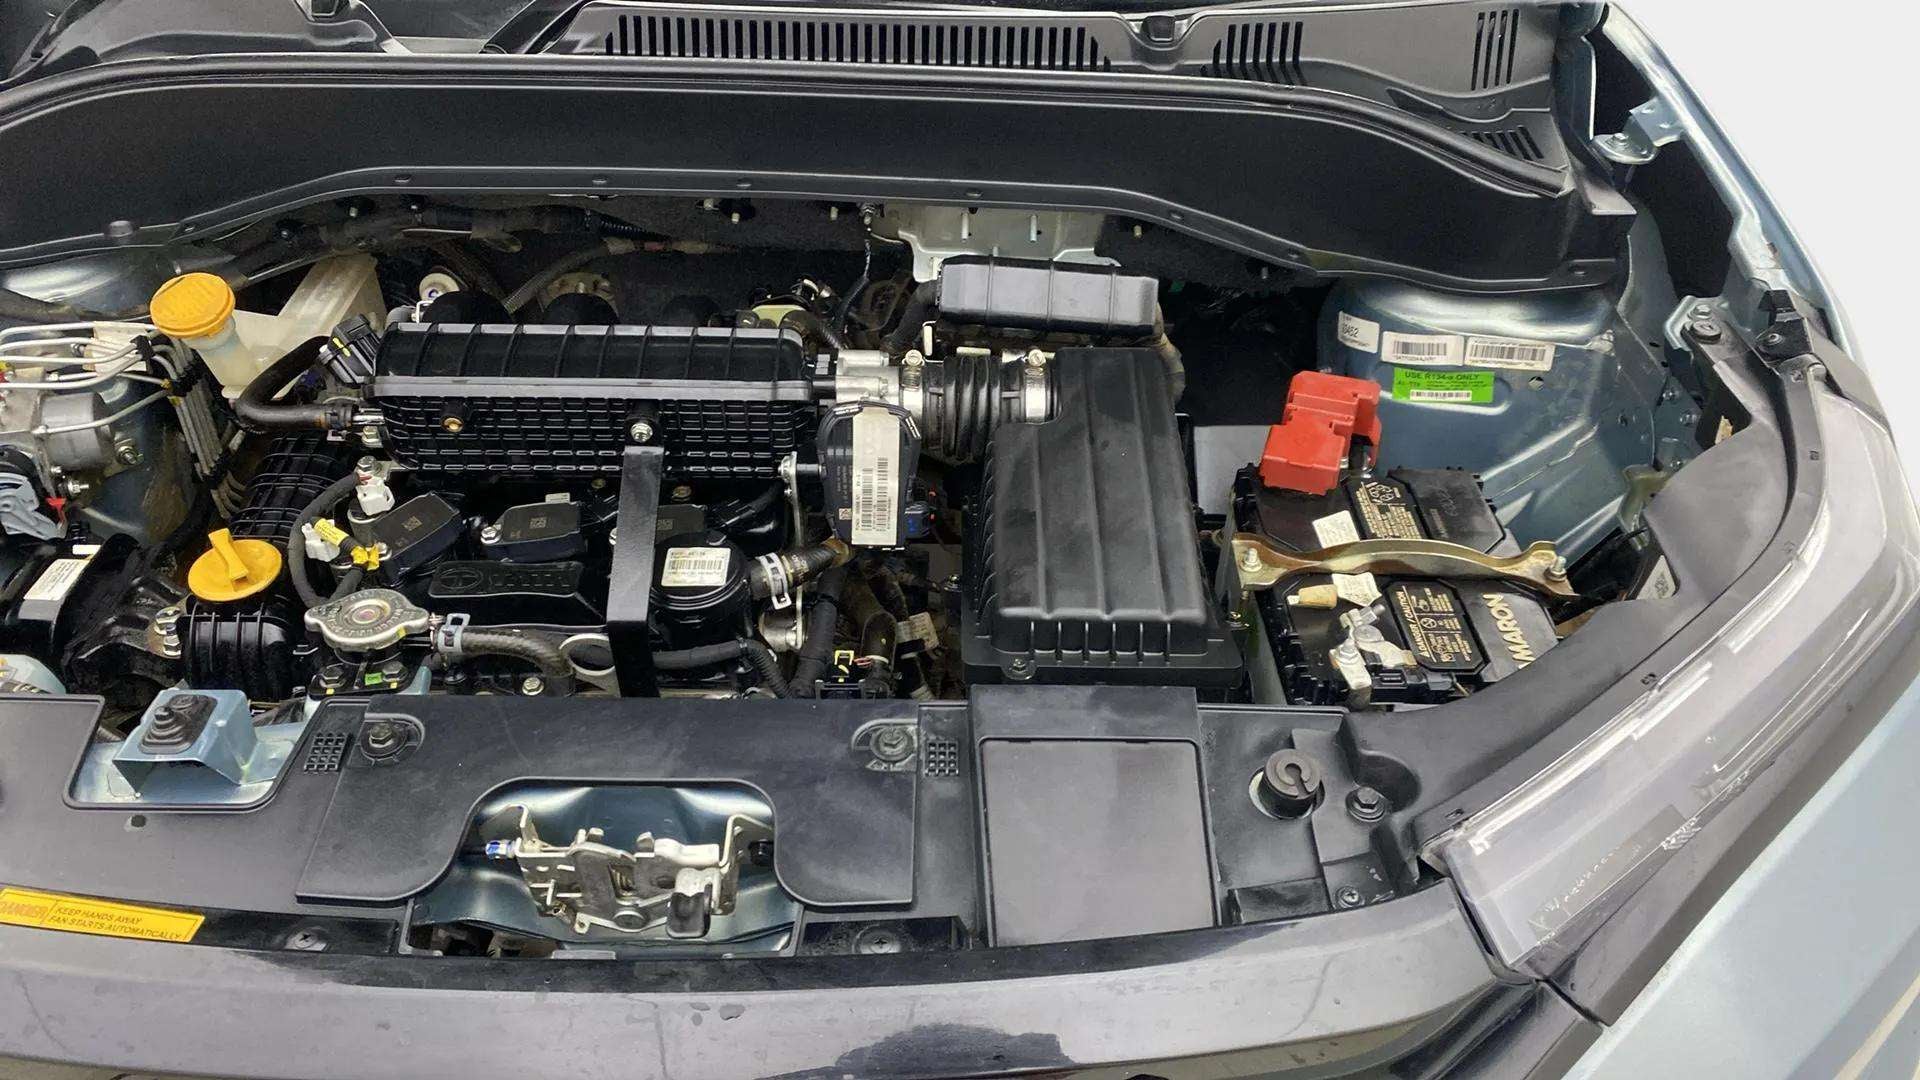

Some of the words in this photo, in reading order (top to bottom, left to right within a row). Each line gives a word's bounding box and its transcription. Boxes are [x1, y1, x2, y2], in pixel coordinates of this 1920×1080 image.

[1405, 371, 1422, 380] USE
[1456, 373, 1480, 381] ONLY
[1395, 590, 1413, 619] CAUTION
[1409, 622, 1427, 653] DANGER
[1482, 592, 1536, 670] MARON
[48, 916, 70, 926] FAN
[70, 918, 105, 930] STARTS
[105, 923, 182, 941] AUTOMATICALLY
[55, 907, 82, 918] KEEP
[82, 910, 114, 922] HANDS
[114, 914, 143, 924] AWAY
